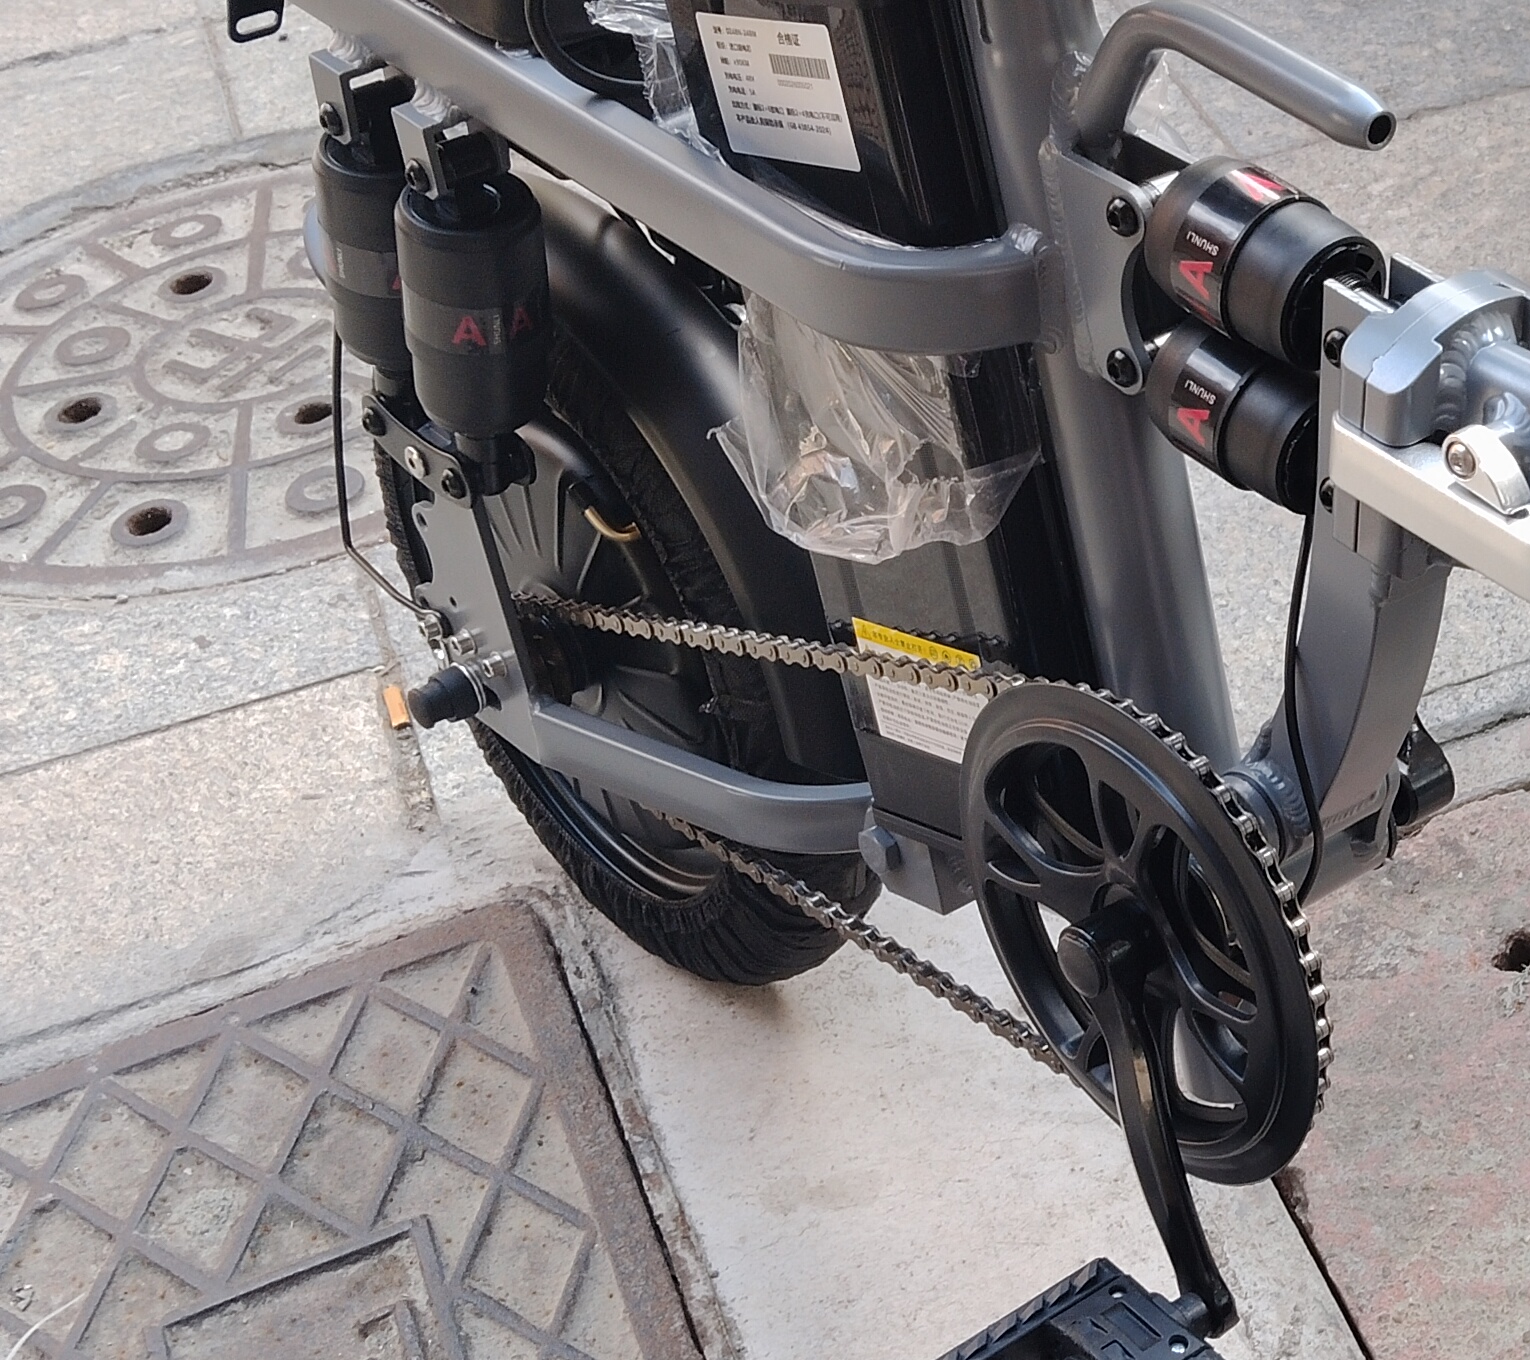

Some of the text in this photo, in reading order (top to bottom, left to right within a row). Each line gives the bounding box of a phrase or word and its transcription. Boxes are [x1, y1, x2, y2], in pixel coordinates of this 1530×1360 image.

[776, 31, 801, 47] 合格证
[1187, 231, 1220, 257] SHUNLI
[1184, 379, 1217, 405] SHUNLI
